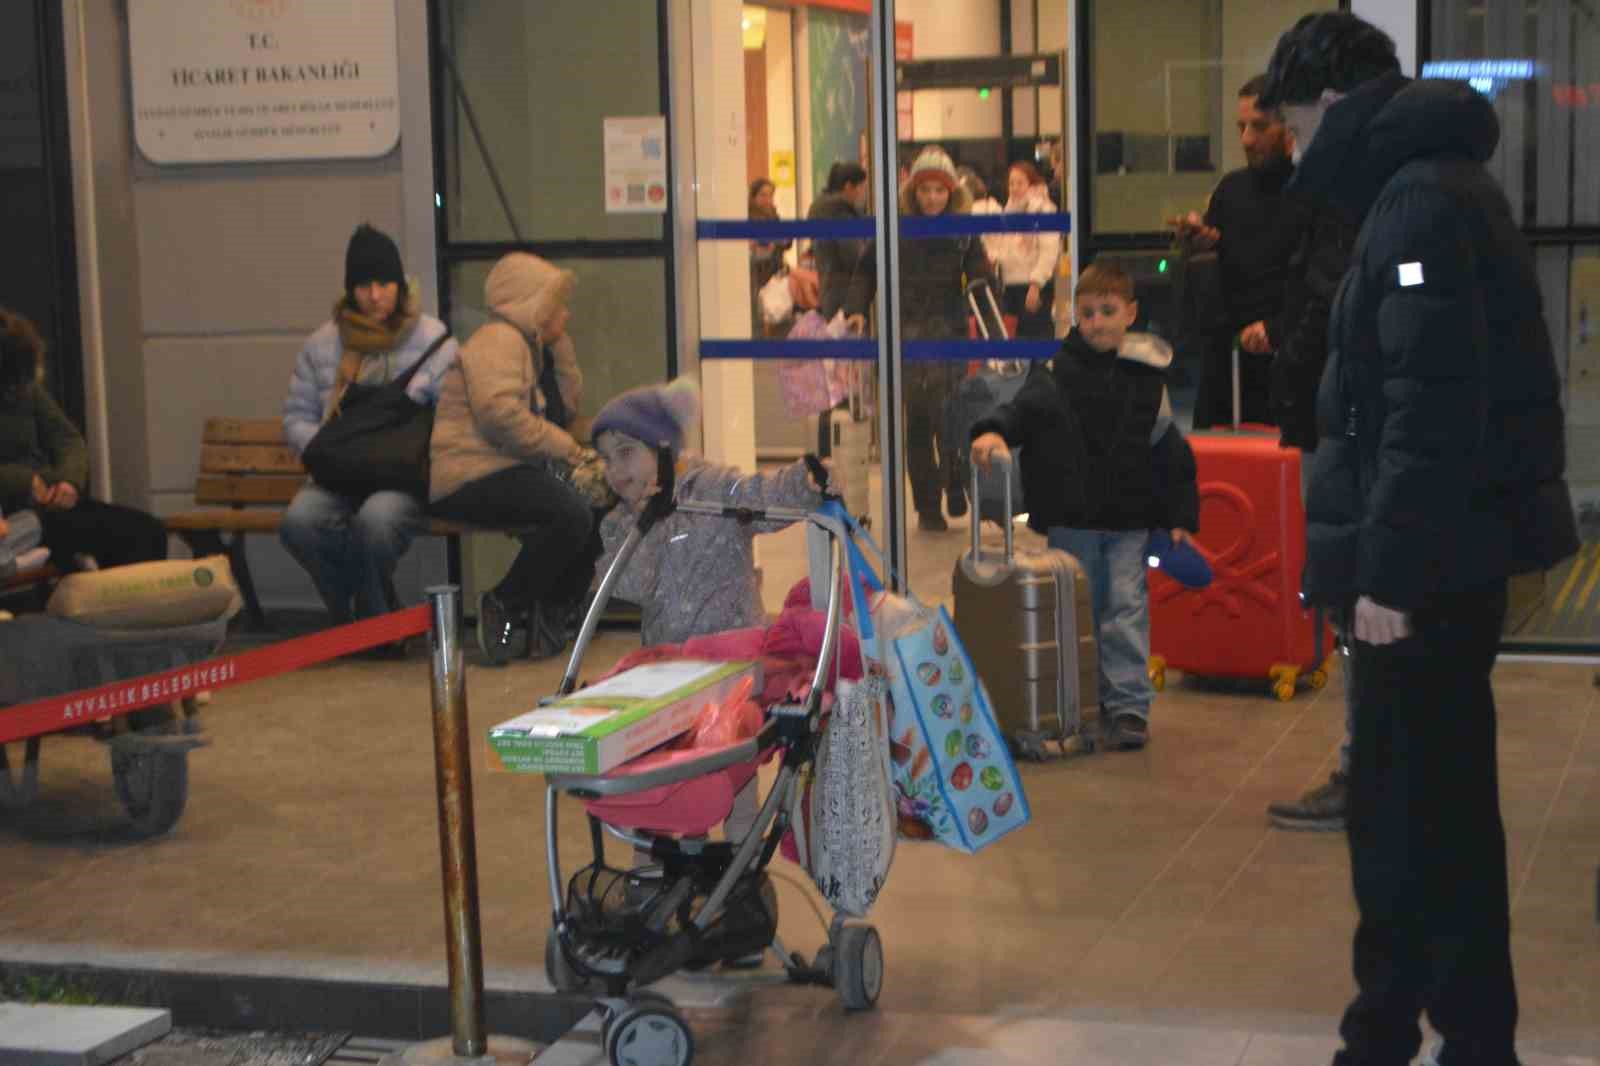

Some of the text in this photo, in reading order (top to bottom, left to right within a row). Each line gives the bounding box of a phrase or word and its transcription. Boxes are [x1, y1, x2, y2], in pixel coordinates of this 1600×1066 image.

[171, 59, 360, 87] TİCARET BAKANLIĞI
[64, 660, 236, 720] AYVALIK BELEDİYESİ
